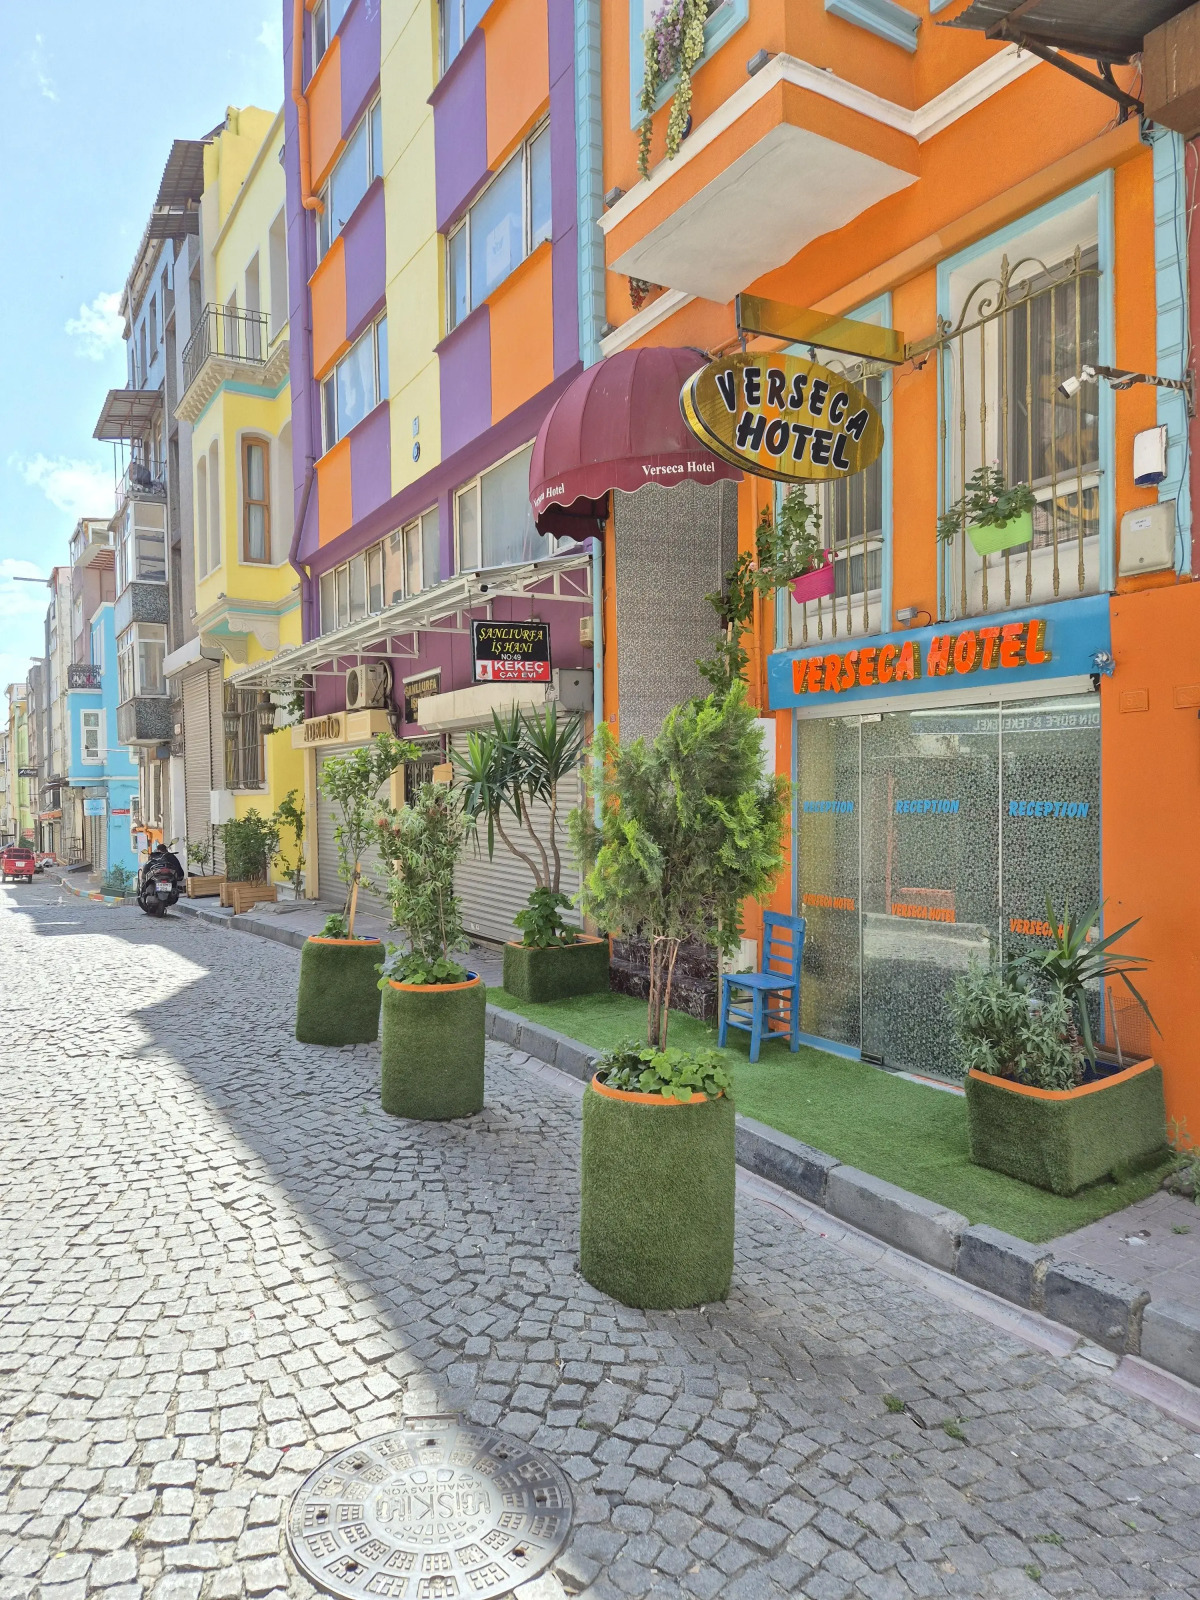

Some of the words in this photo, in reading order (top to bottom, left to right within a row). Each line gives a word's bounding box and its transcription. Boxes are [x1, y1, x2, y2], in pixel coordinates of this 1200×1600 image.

[715, 367, 869, 442] VERSECA
[736, 410, 850, 471] HOTEL
[641, 464, 684, 476] Verseca
[687, 461, 715, 472] Hotel
[546, 482, 565, 498] Hotel
[791, 641, 917, 695] VERSECA
[926, 618, 1049, 677] HOTEL
[494, 661, 544, 674] KEKEÇ
[499, 671, 519, 679] ÇAY
[803, 801, 855, 813] RECEPTION
[895, 799, 960, 814] RECEPTION
[1008, 800, 1090, 818] RECEPTION
[803, 893, 832, 907] VERSECA
[833, 897, 855, 911] HOTEL
[891, 903, 927, 918] VERSECA
[928, 907, 956, 923] HOTEL
